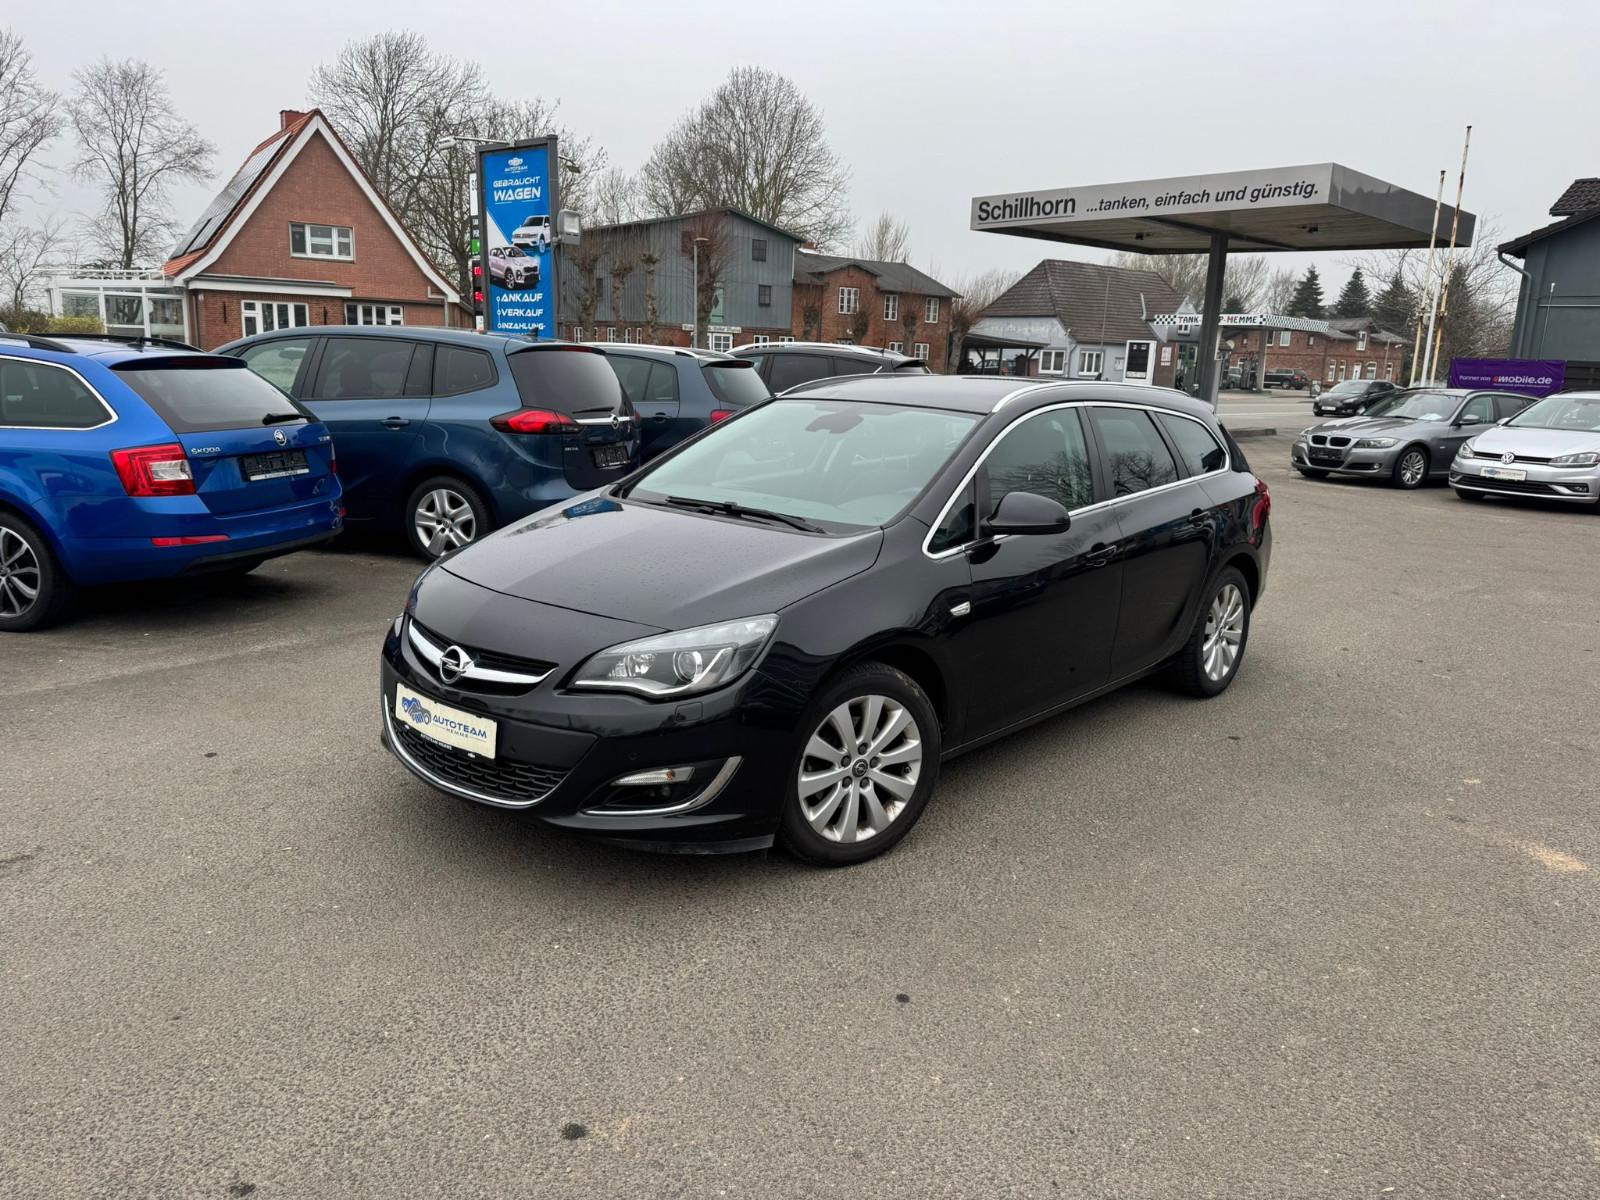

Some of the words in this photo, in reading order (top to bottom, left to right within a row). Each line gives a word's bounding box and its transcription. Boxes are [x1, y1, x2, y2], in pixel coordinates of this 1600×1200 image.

[493, 176, 541, 188] GEBRAUCHT
[494, 186, 541, 202] WAGEN
[978, 196, 1076, 222] Schillhorn
[1086, 195, 1149, 212] ...tanken,
[1154, 189, 1210, 207] einfach
[1215, 185, 1248, 202] und
[1250, 180, 1319, 203] günstig.
[501, 293, 544, 303] ANKAUF
[501, 308, 544, 317] VERKAUF
[432, 714, 487, 739] AUTOTEAM
[446, 727, 469, 739] HEMME
